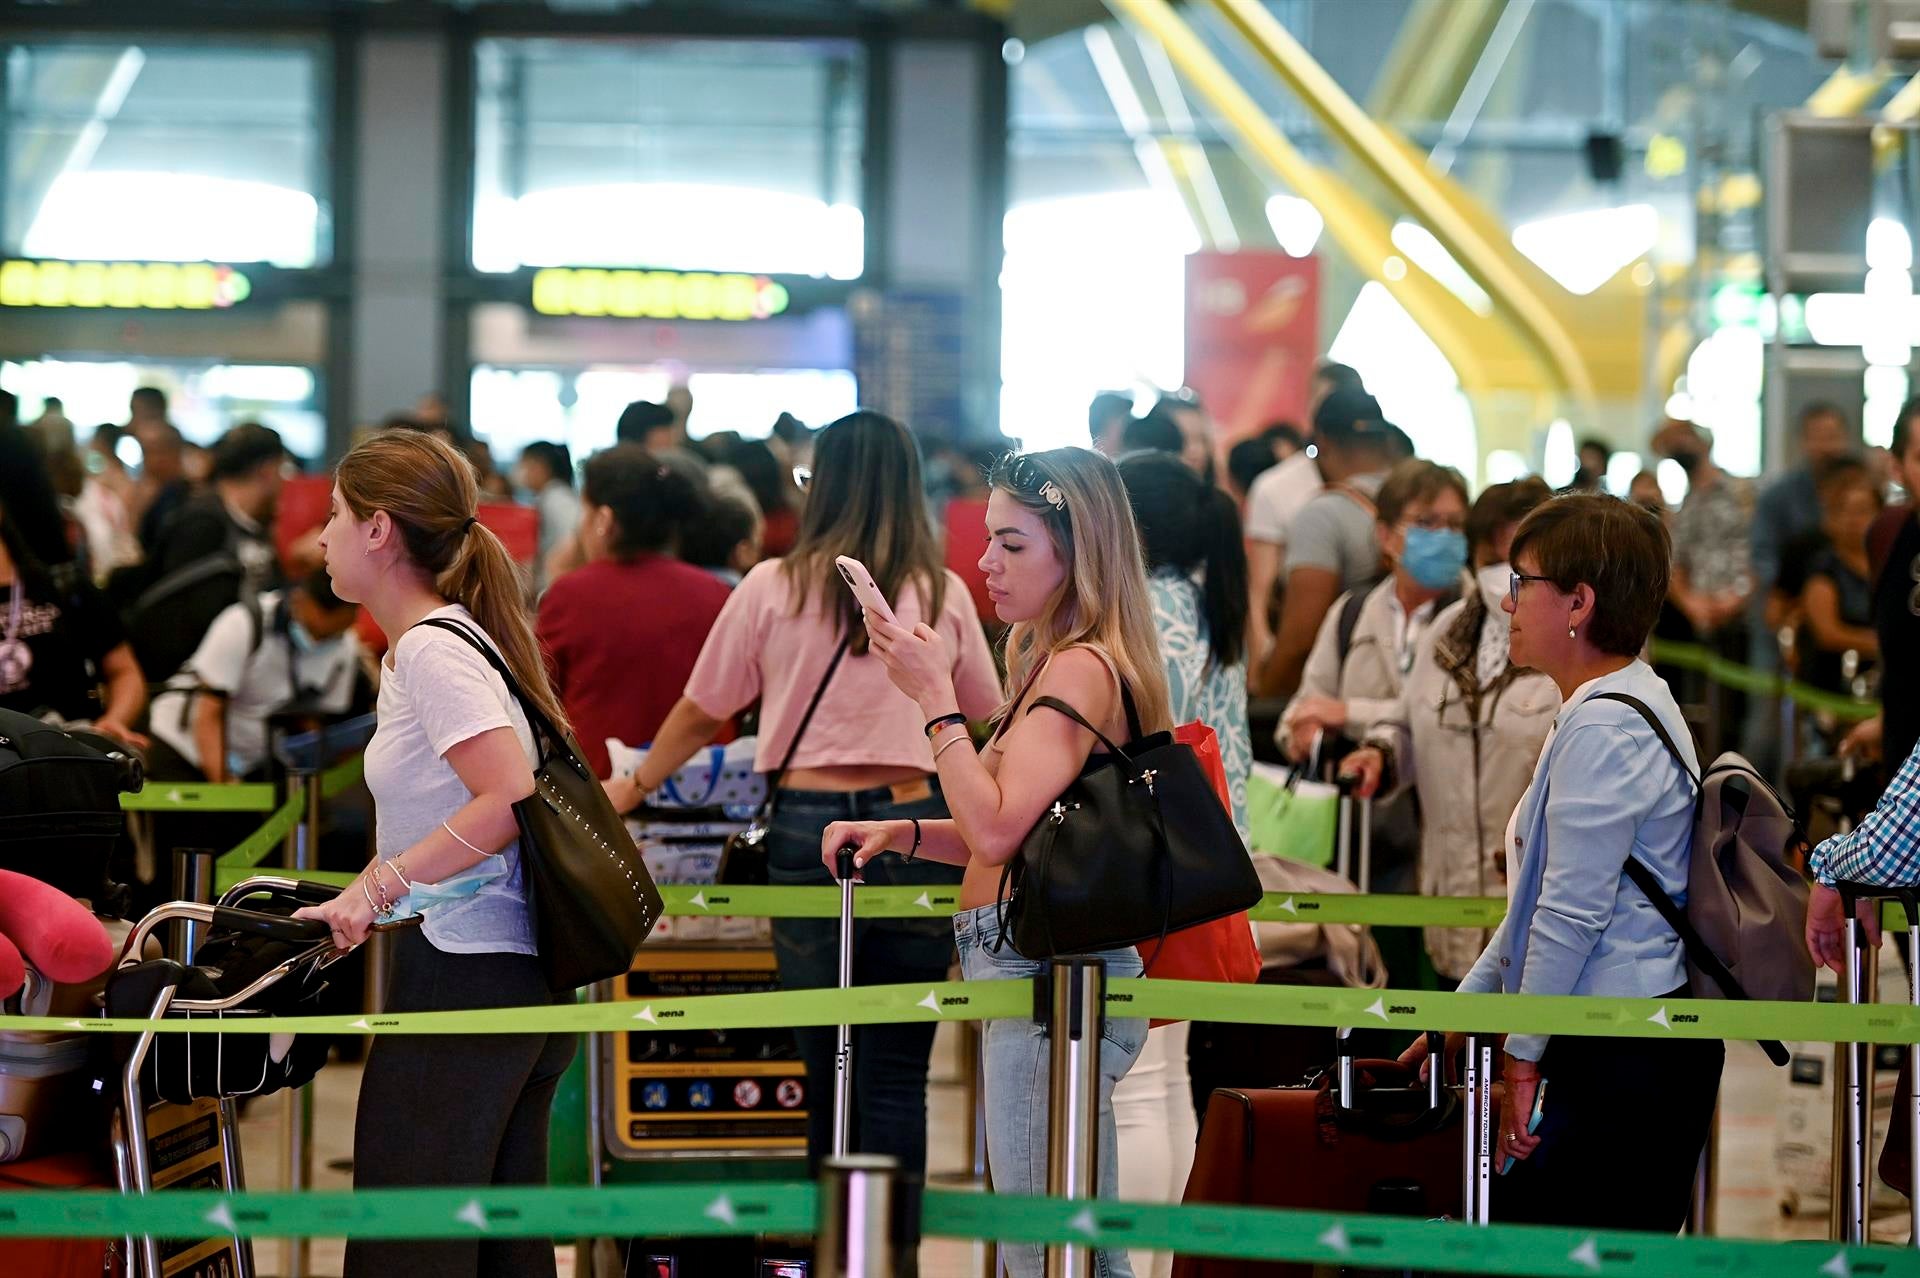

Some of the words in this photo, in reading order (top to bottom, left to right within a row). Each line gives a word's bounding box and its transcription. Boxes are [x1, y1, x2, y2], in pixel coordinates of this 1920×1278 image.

[707, 896, 730, 905] aena
[933, 896, 955, 905] aena
[1297, 902, 1320, 910] aena
[942, 996, 969, 1006] aena
[1106, 992, 1134, 1003] aena
[657, 1009, 685, 1018] aena
[1388, 1005, 1416, 1015] aena
[1671, 1014, 1699, 1023] aena
